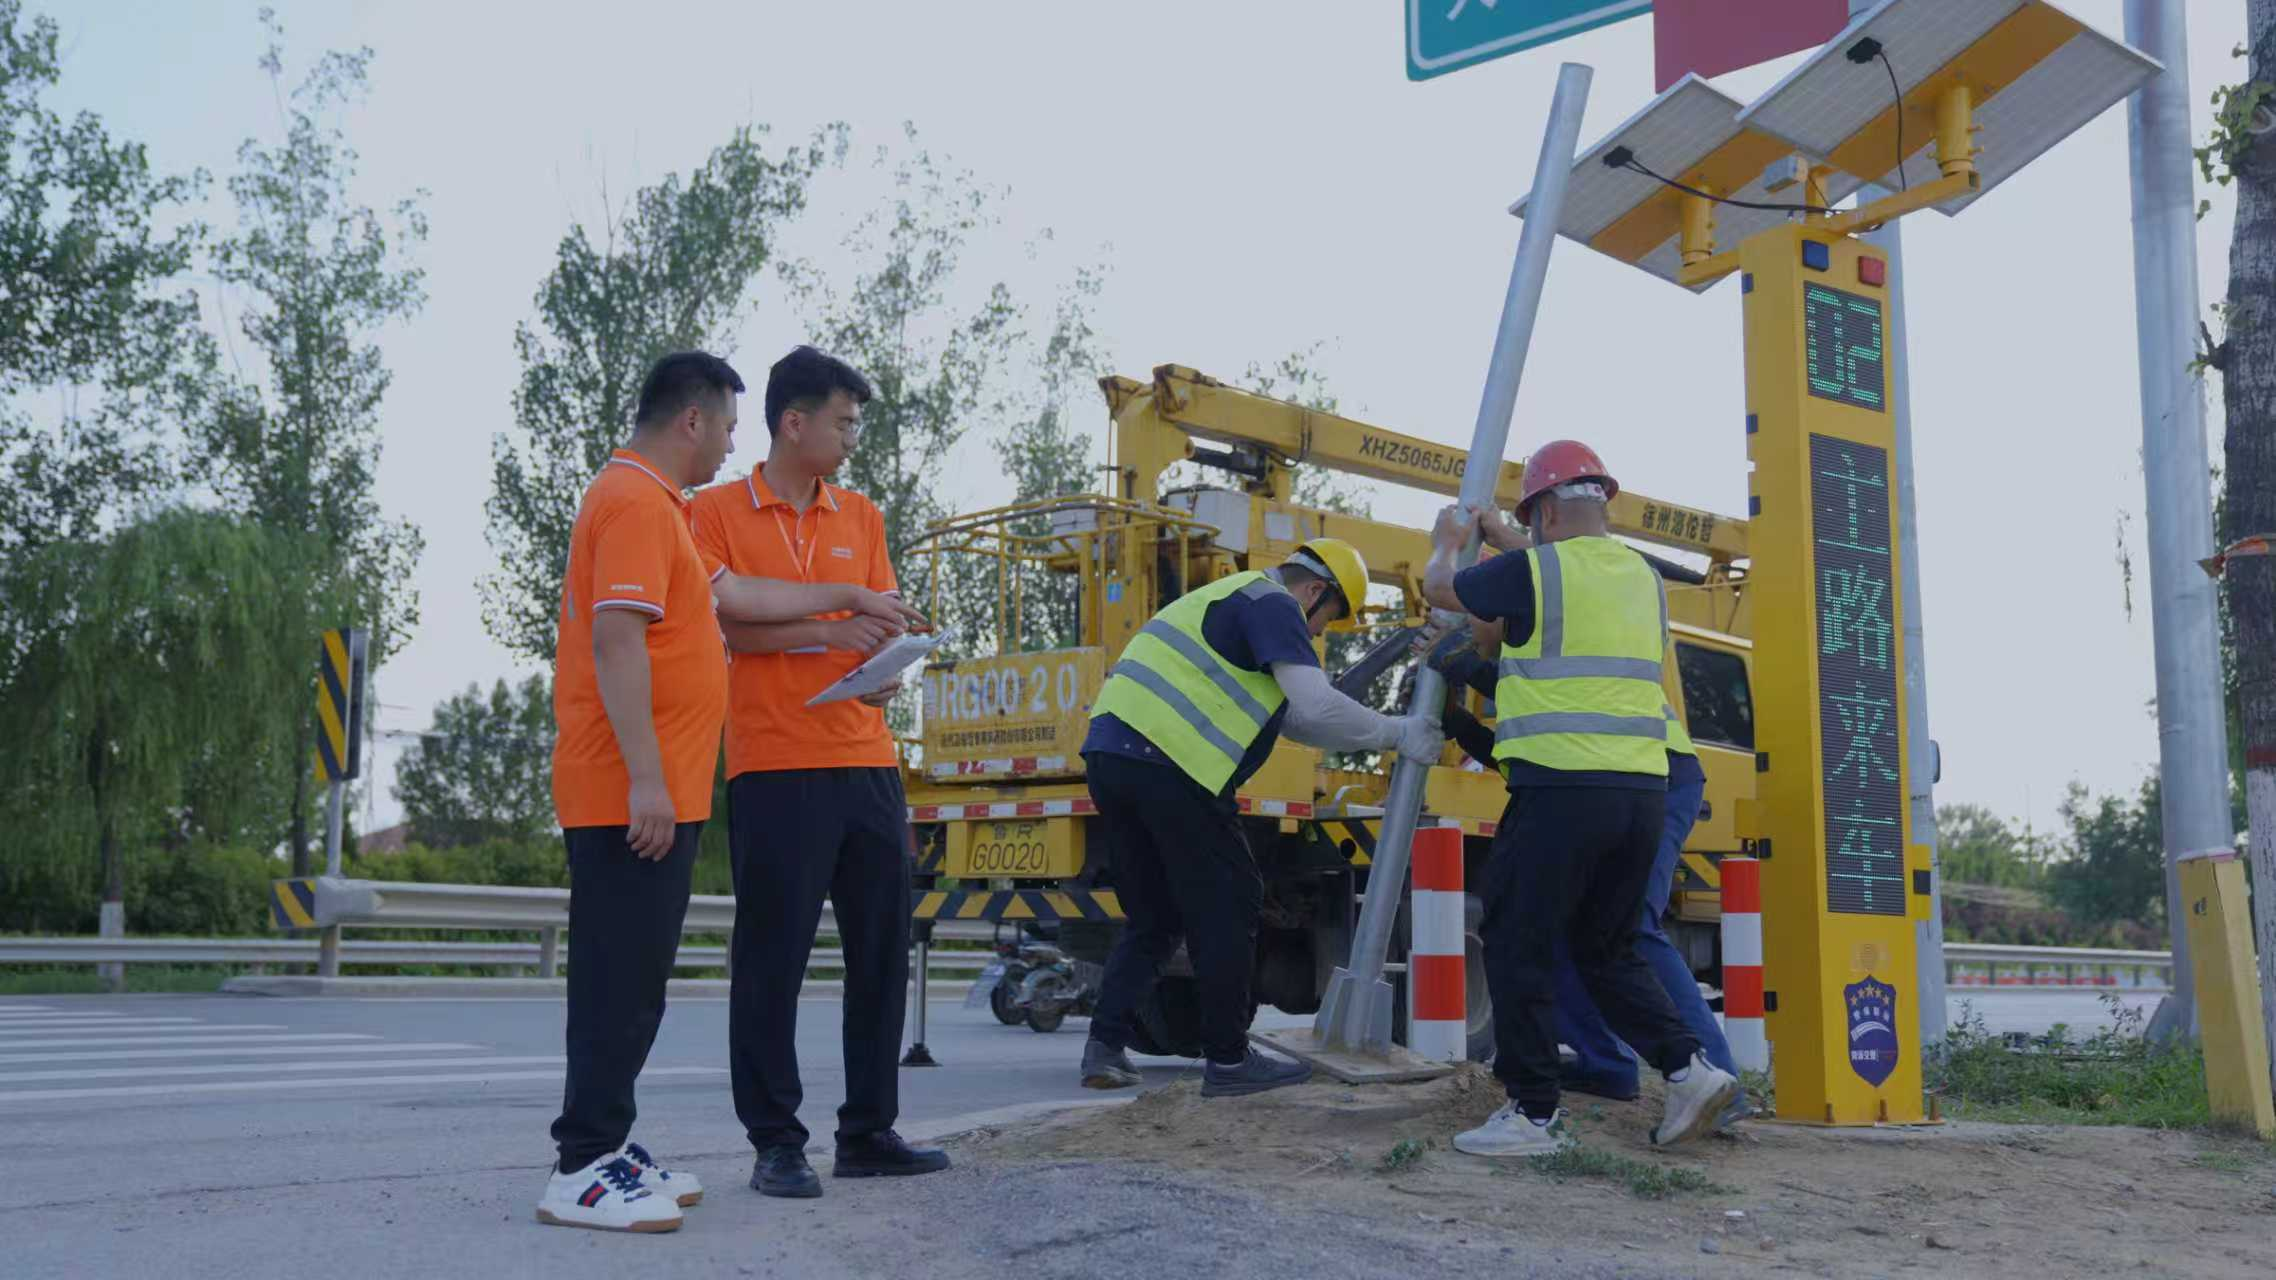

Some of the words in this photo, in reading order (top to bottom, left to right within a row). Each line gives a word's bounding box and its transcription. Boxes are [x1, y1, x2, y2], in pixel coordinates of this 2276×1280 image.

[1807, 287, 1881, 404] 02
[1359, 433, 1466, 478] XHZ5065JG
[1817, 452, 1904, 911] 主路来车
[973, 842, 1045, 871] G0020
